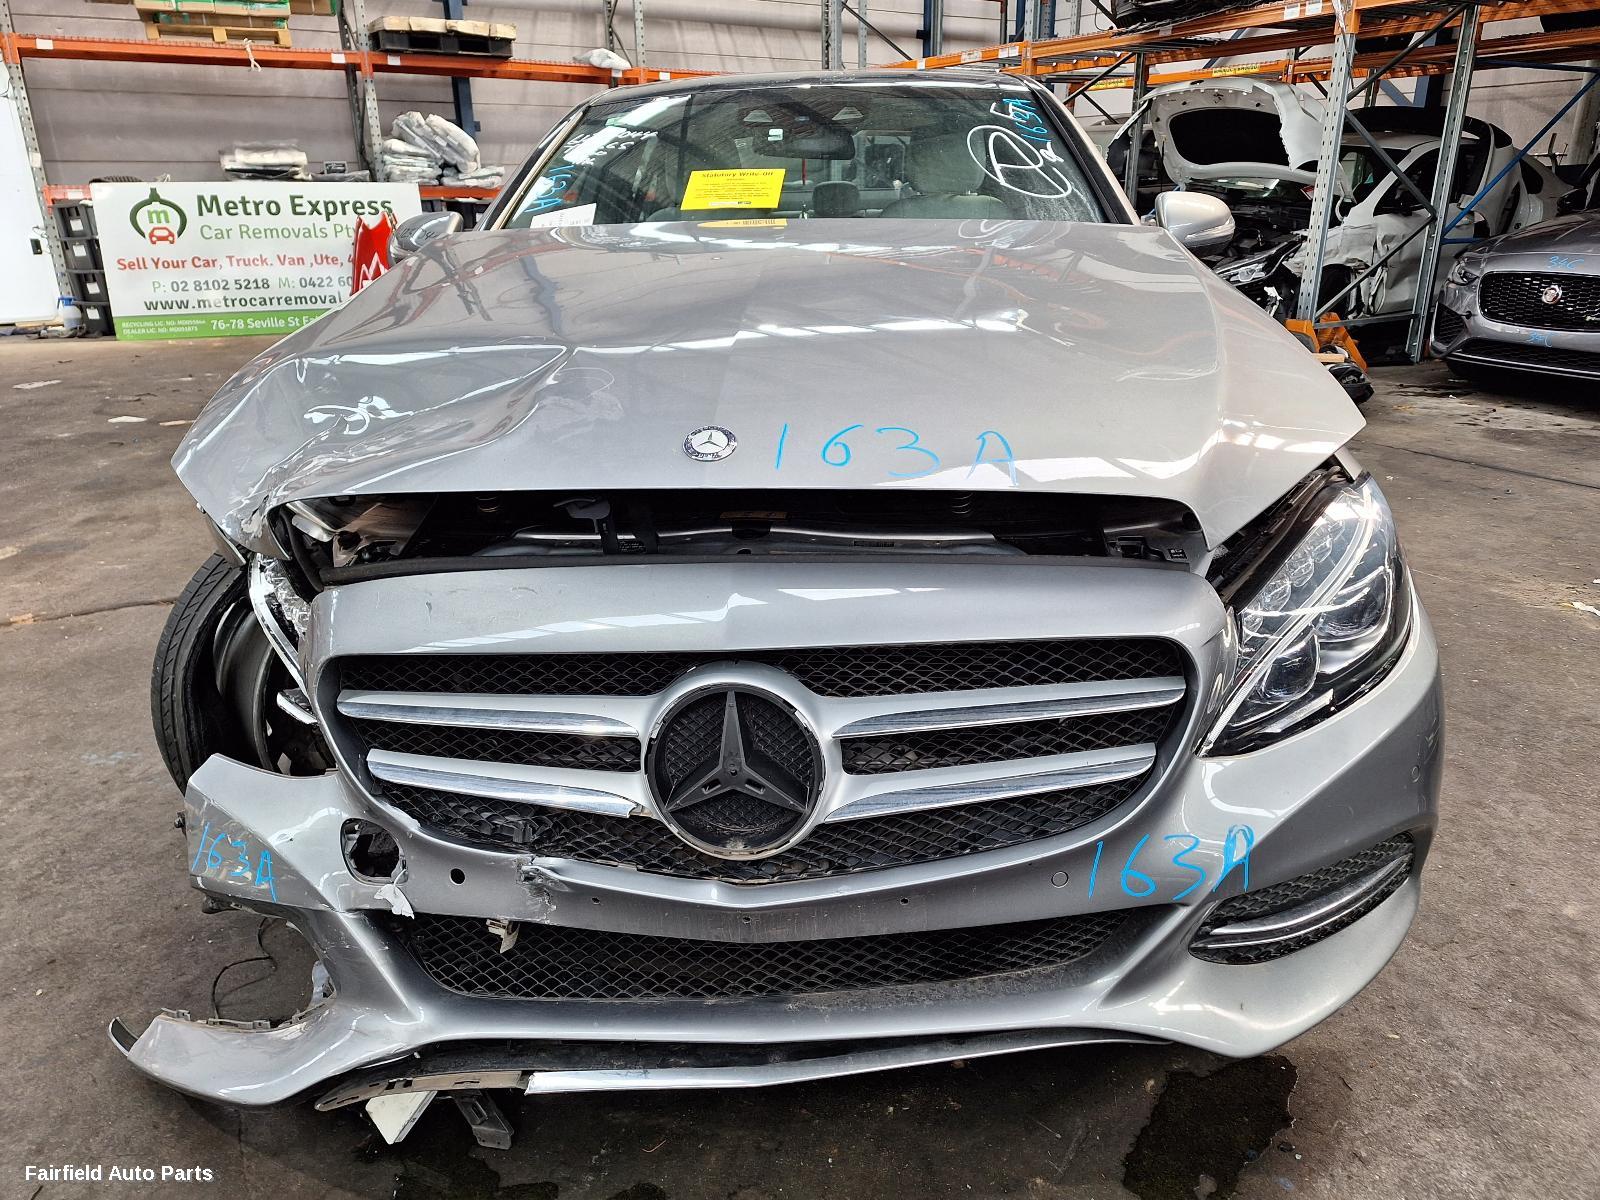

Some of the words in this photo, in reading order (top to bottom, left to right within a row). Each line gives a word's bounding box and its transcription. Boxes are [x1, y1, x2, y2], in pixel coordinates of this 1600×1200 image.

[197, 194, 281, 217] Metro
[289, 194, 393, 222] Express
[200, 224, 232, 240] Car
[239, 222, 328, 240] Removals
[117, 257, 148, 270] Sell
[151, 257, 187, 270] Your
[191, 256, 223, 270] Car,
[277, 254, 305, 267] Van
[152, 281, 167, 293] P:
[171, 280, 189, 293] 02
[194, 279, 230, 291] 8102
[235, 278, 270, 290] 5218
[278, 277, 295, 289] M:
[300, 276, 333, 288] 0422
[211, 319, 245, 330] 76-78
[247, 317, 285, 329] Seville
[288, 316, 300, 327] St
[191, 821, 277, 904] 163A
[1088, 824, 1255, 902] 163A
